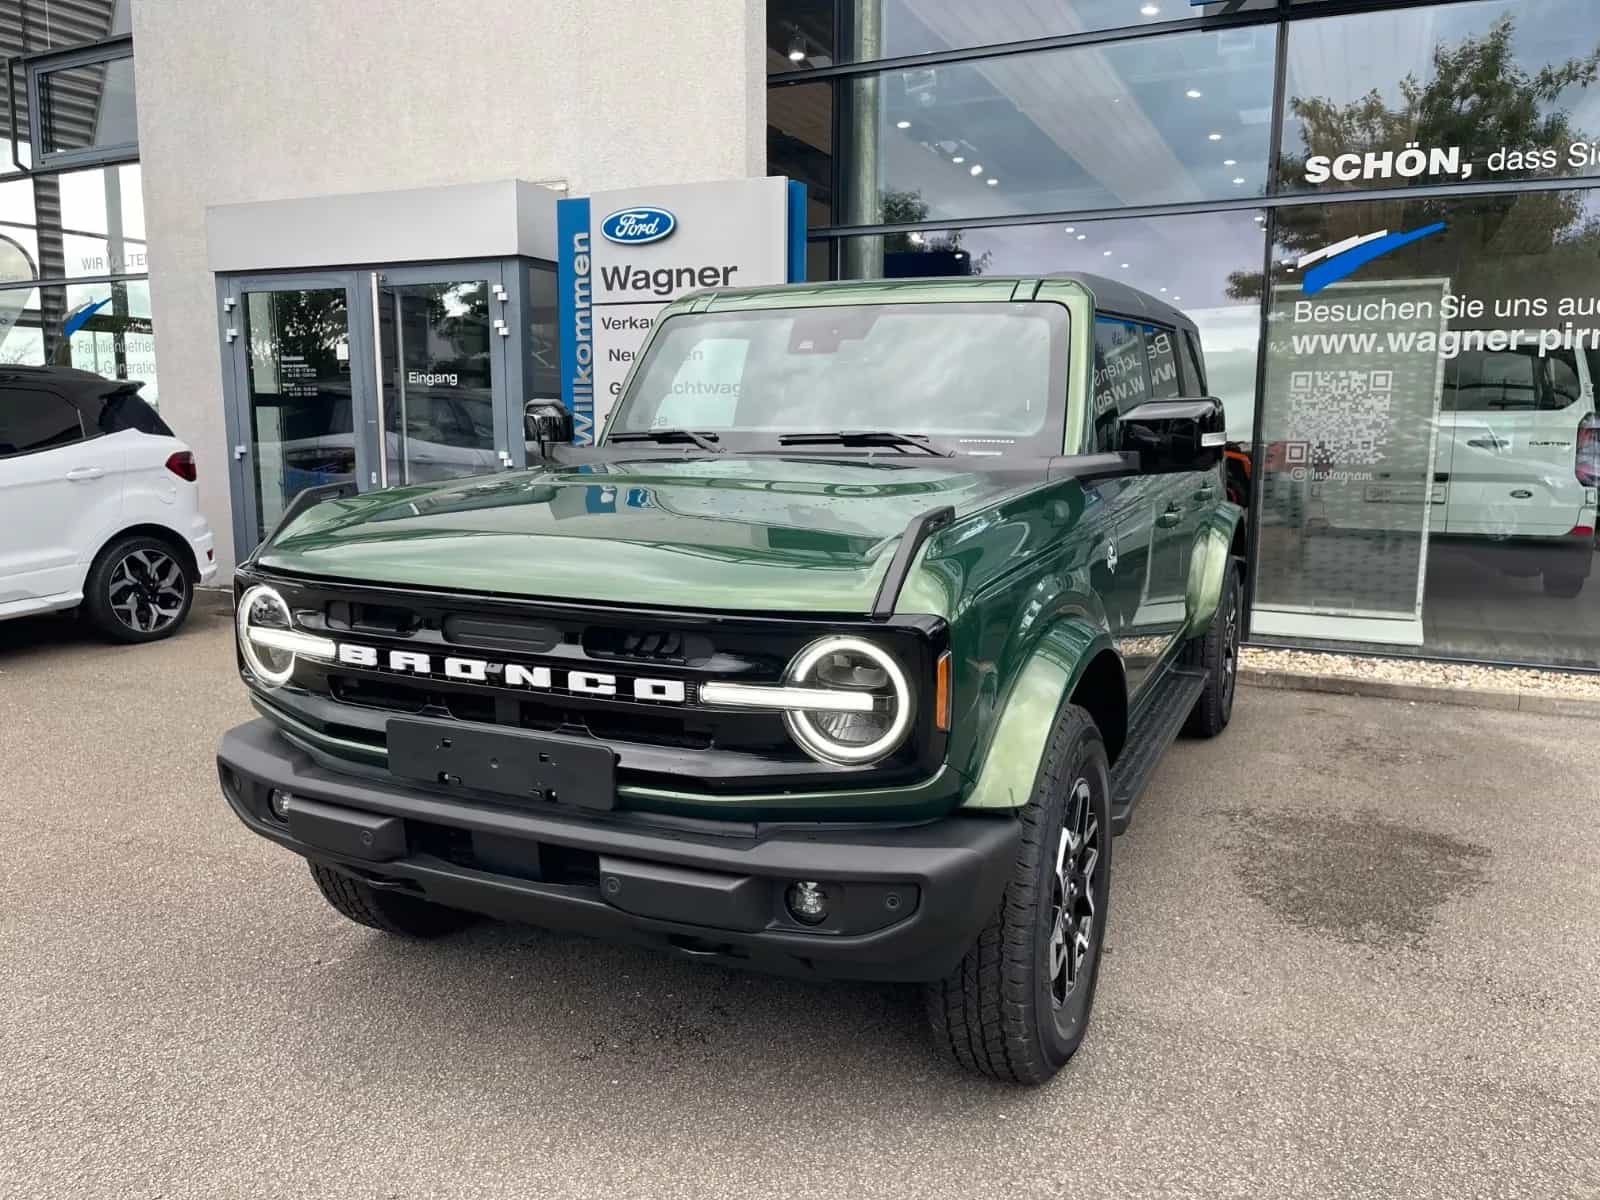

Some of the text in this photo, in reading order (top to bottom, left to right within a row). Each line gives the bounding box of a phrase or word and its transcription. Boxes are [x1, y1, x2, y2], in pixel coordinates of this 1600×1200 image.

[1304, 141, 1600, 183] SCHÖN, dass Si
[81, 256, 104, 270] WIR
[600, 264, 738, 295] Wagner
[1294, 294, 1600, 323] Besuchen Sie uns au
[572, 232, 592, 446] Willkommen
[408, 371, 458, 386] Eingang
[1311, 466, 1373, 485] Instagram
[338, 643, 686, 702] BRONCO
